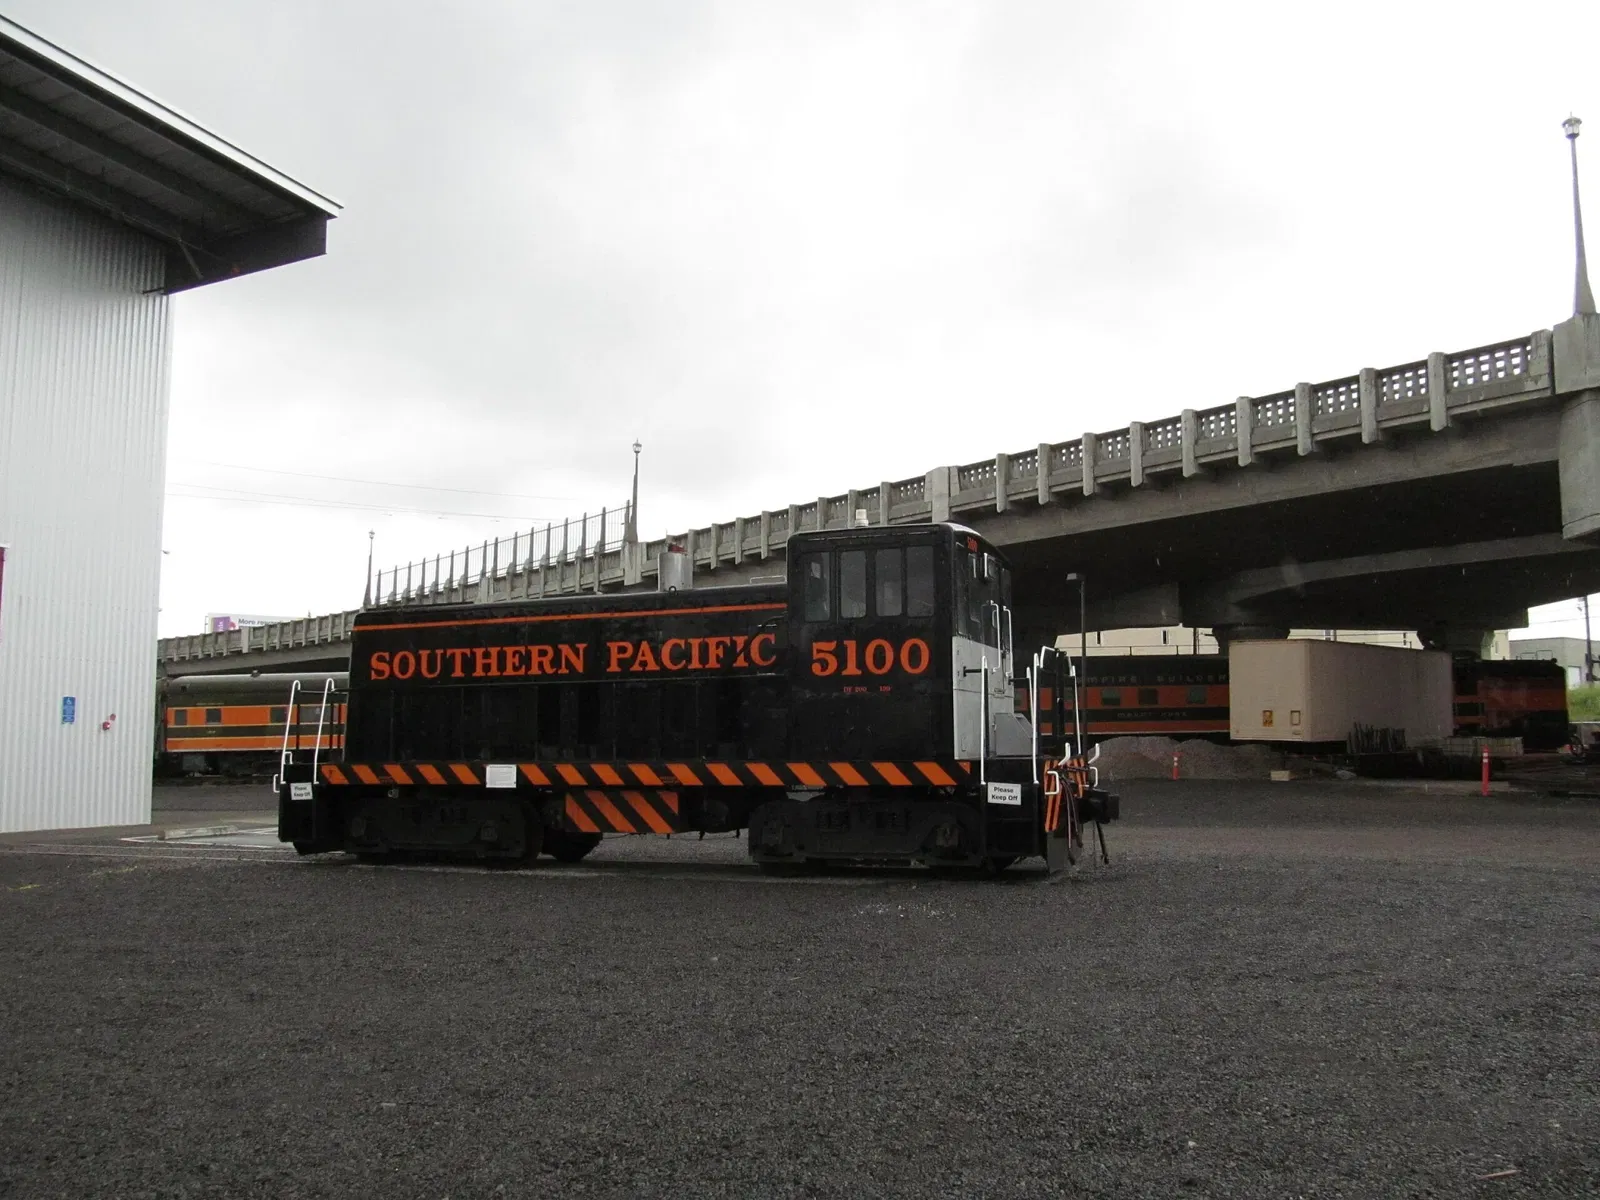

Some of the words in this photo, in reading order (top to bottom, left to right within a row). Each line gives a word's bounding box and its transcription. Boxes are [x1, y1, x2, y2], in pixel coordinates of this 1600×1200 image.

[370, 643, 588, 680] SOUTHERN
[606, 633, 777, 673] PACIFIC
[811, 638, 930, 676] 5100
